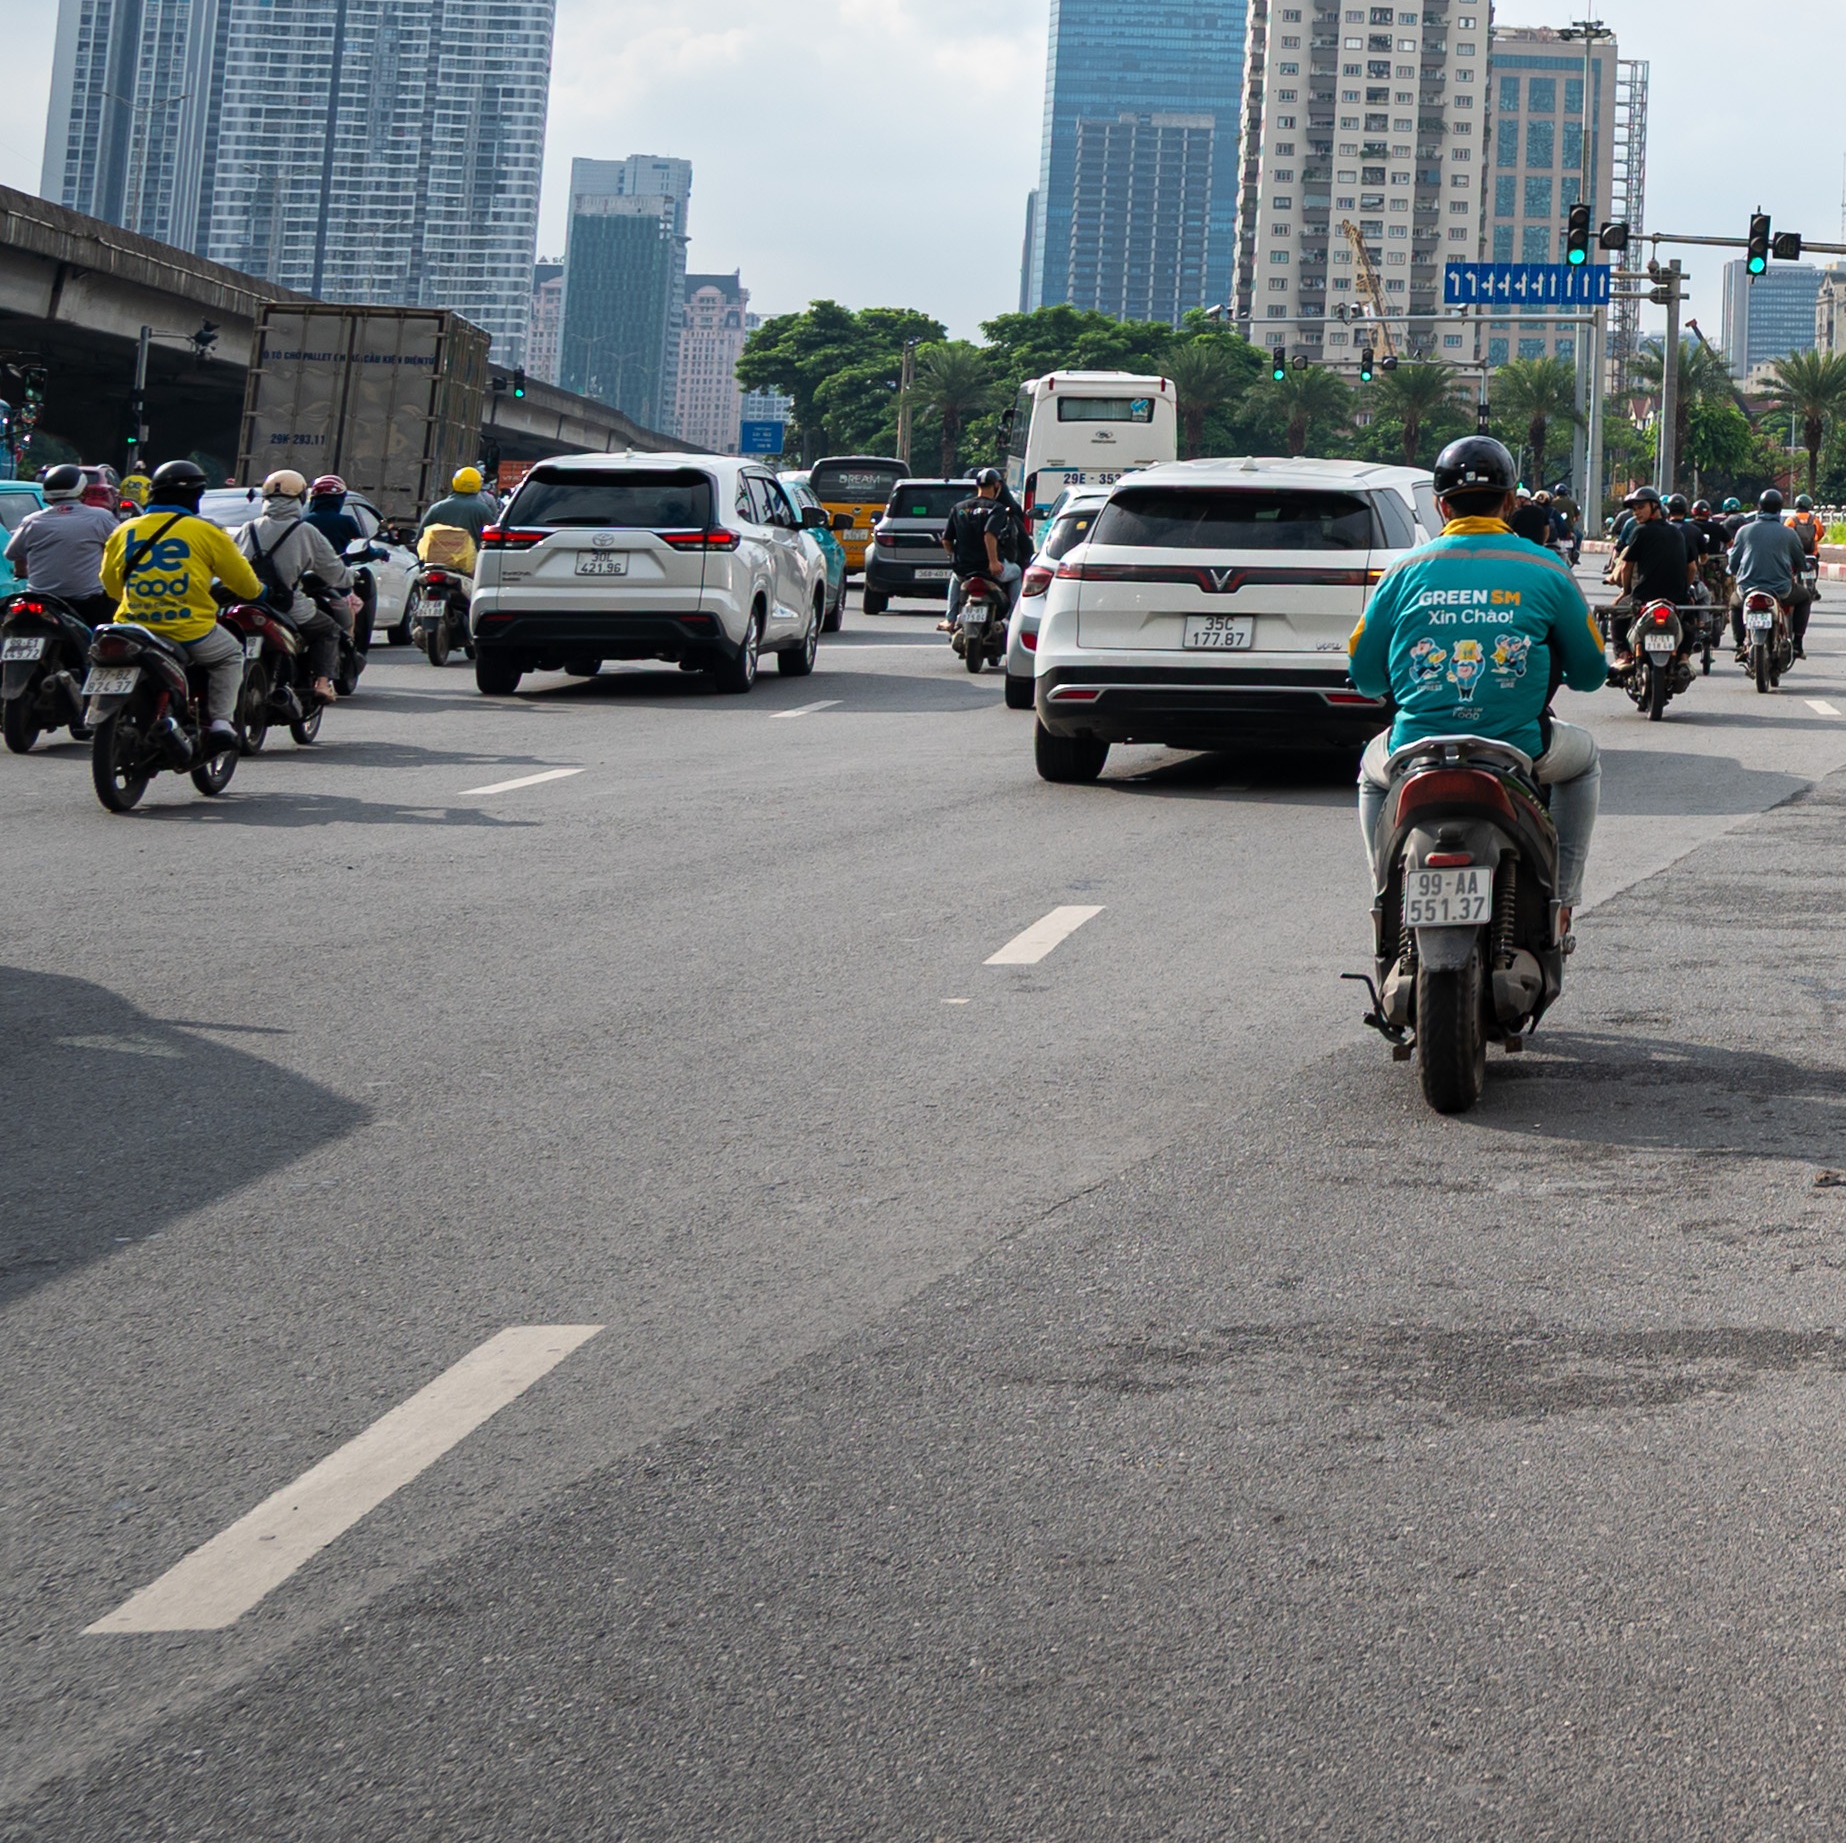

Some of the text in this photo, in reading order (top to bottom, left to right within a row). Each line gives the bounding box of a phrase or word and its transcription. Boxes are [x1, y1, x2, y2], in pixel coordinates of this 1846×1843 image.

[838, 474, 880, 484] DREAM
[1064, 473, 1086, 484] 29E
[124, 529, 190, 572] be
[592, 552, 614, 562] 30L
[581, 563, 621, 574] 421.96
[1418, 589, 1521, 606] GREEN SM
[1428, 609, 1514, 625] Xin Chào!
[1205, 618, 1234, 631] 35C
[1193, 632, 1245, 646] 177.87
[86, 681, 132, 692] 824.37
[1419, 872, 1478, 896] 99-AA
[1410, 897, 1485, 922] 551.37
